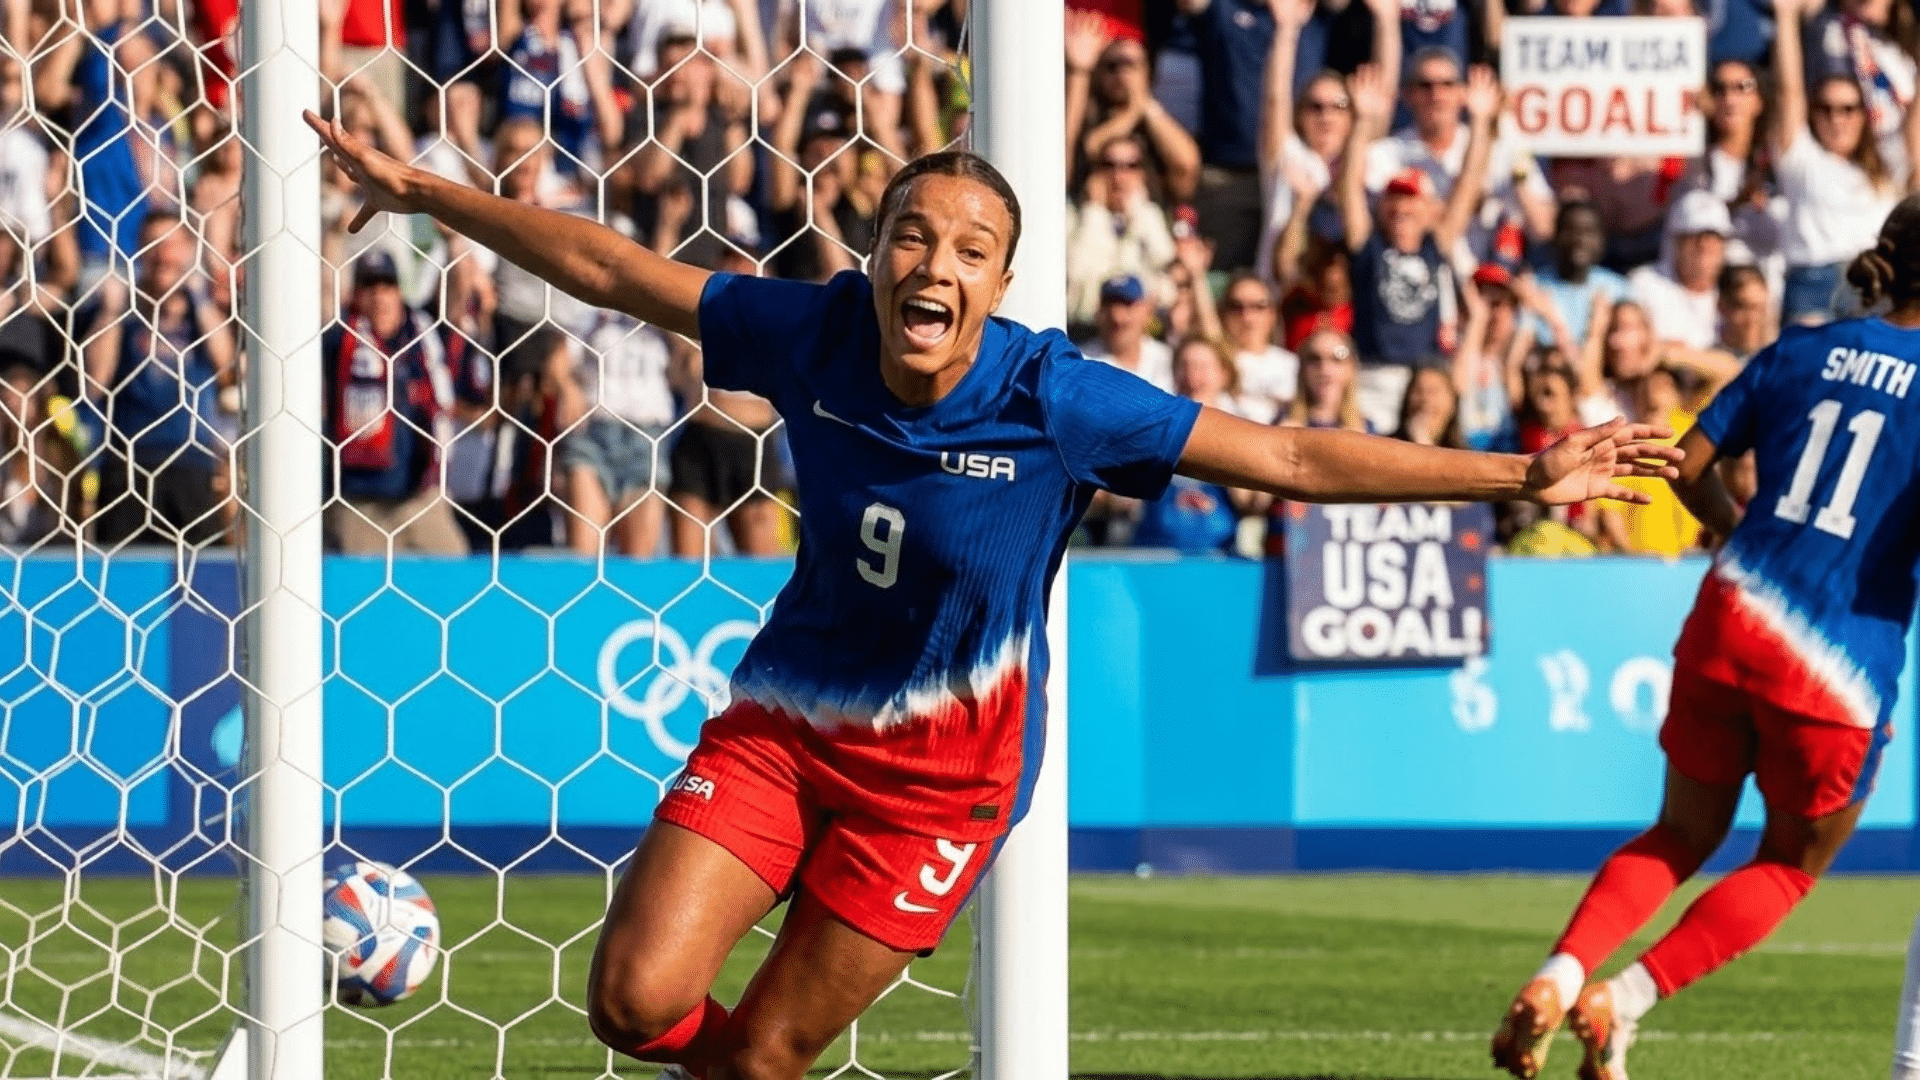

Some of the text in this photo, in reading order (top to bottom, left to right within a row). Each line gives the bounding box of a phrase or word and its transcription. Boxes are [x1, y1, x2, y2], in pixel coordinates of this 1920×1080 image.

[1516, 35, 1690, 73] TEAM USA
[1821, 346, 1917, 399] SMITH
[940, 450, 1015, 482] USA
[1775, 399, 1886, 540] 11
[856, 502, 905, 589] 9
[1323, 503, 1453, 543] TEAM
[1322, 540, 1455, 609] USA
[1301, 605, 1482, 658] GOAL!
